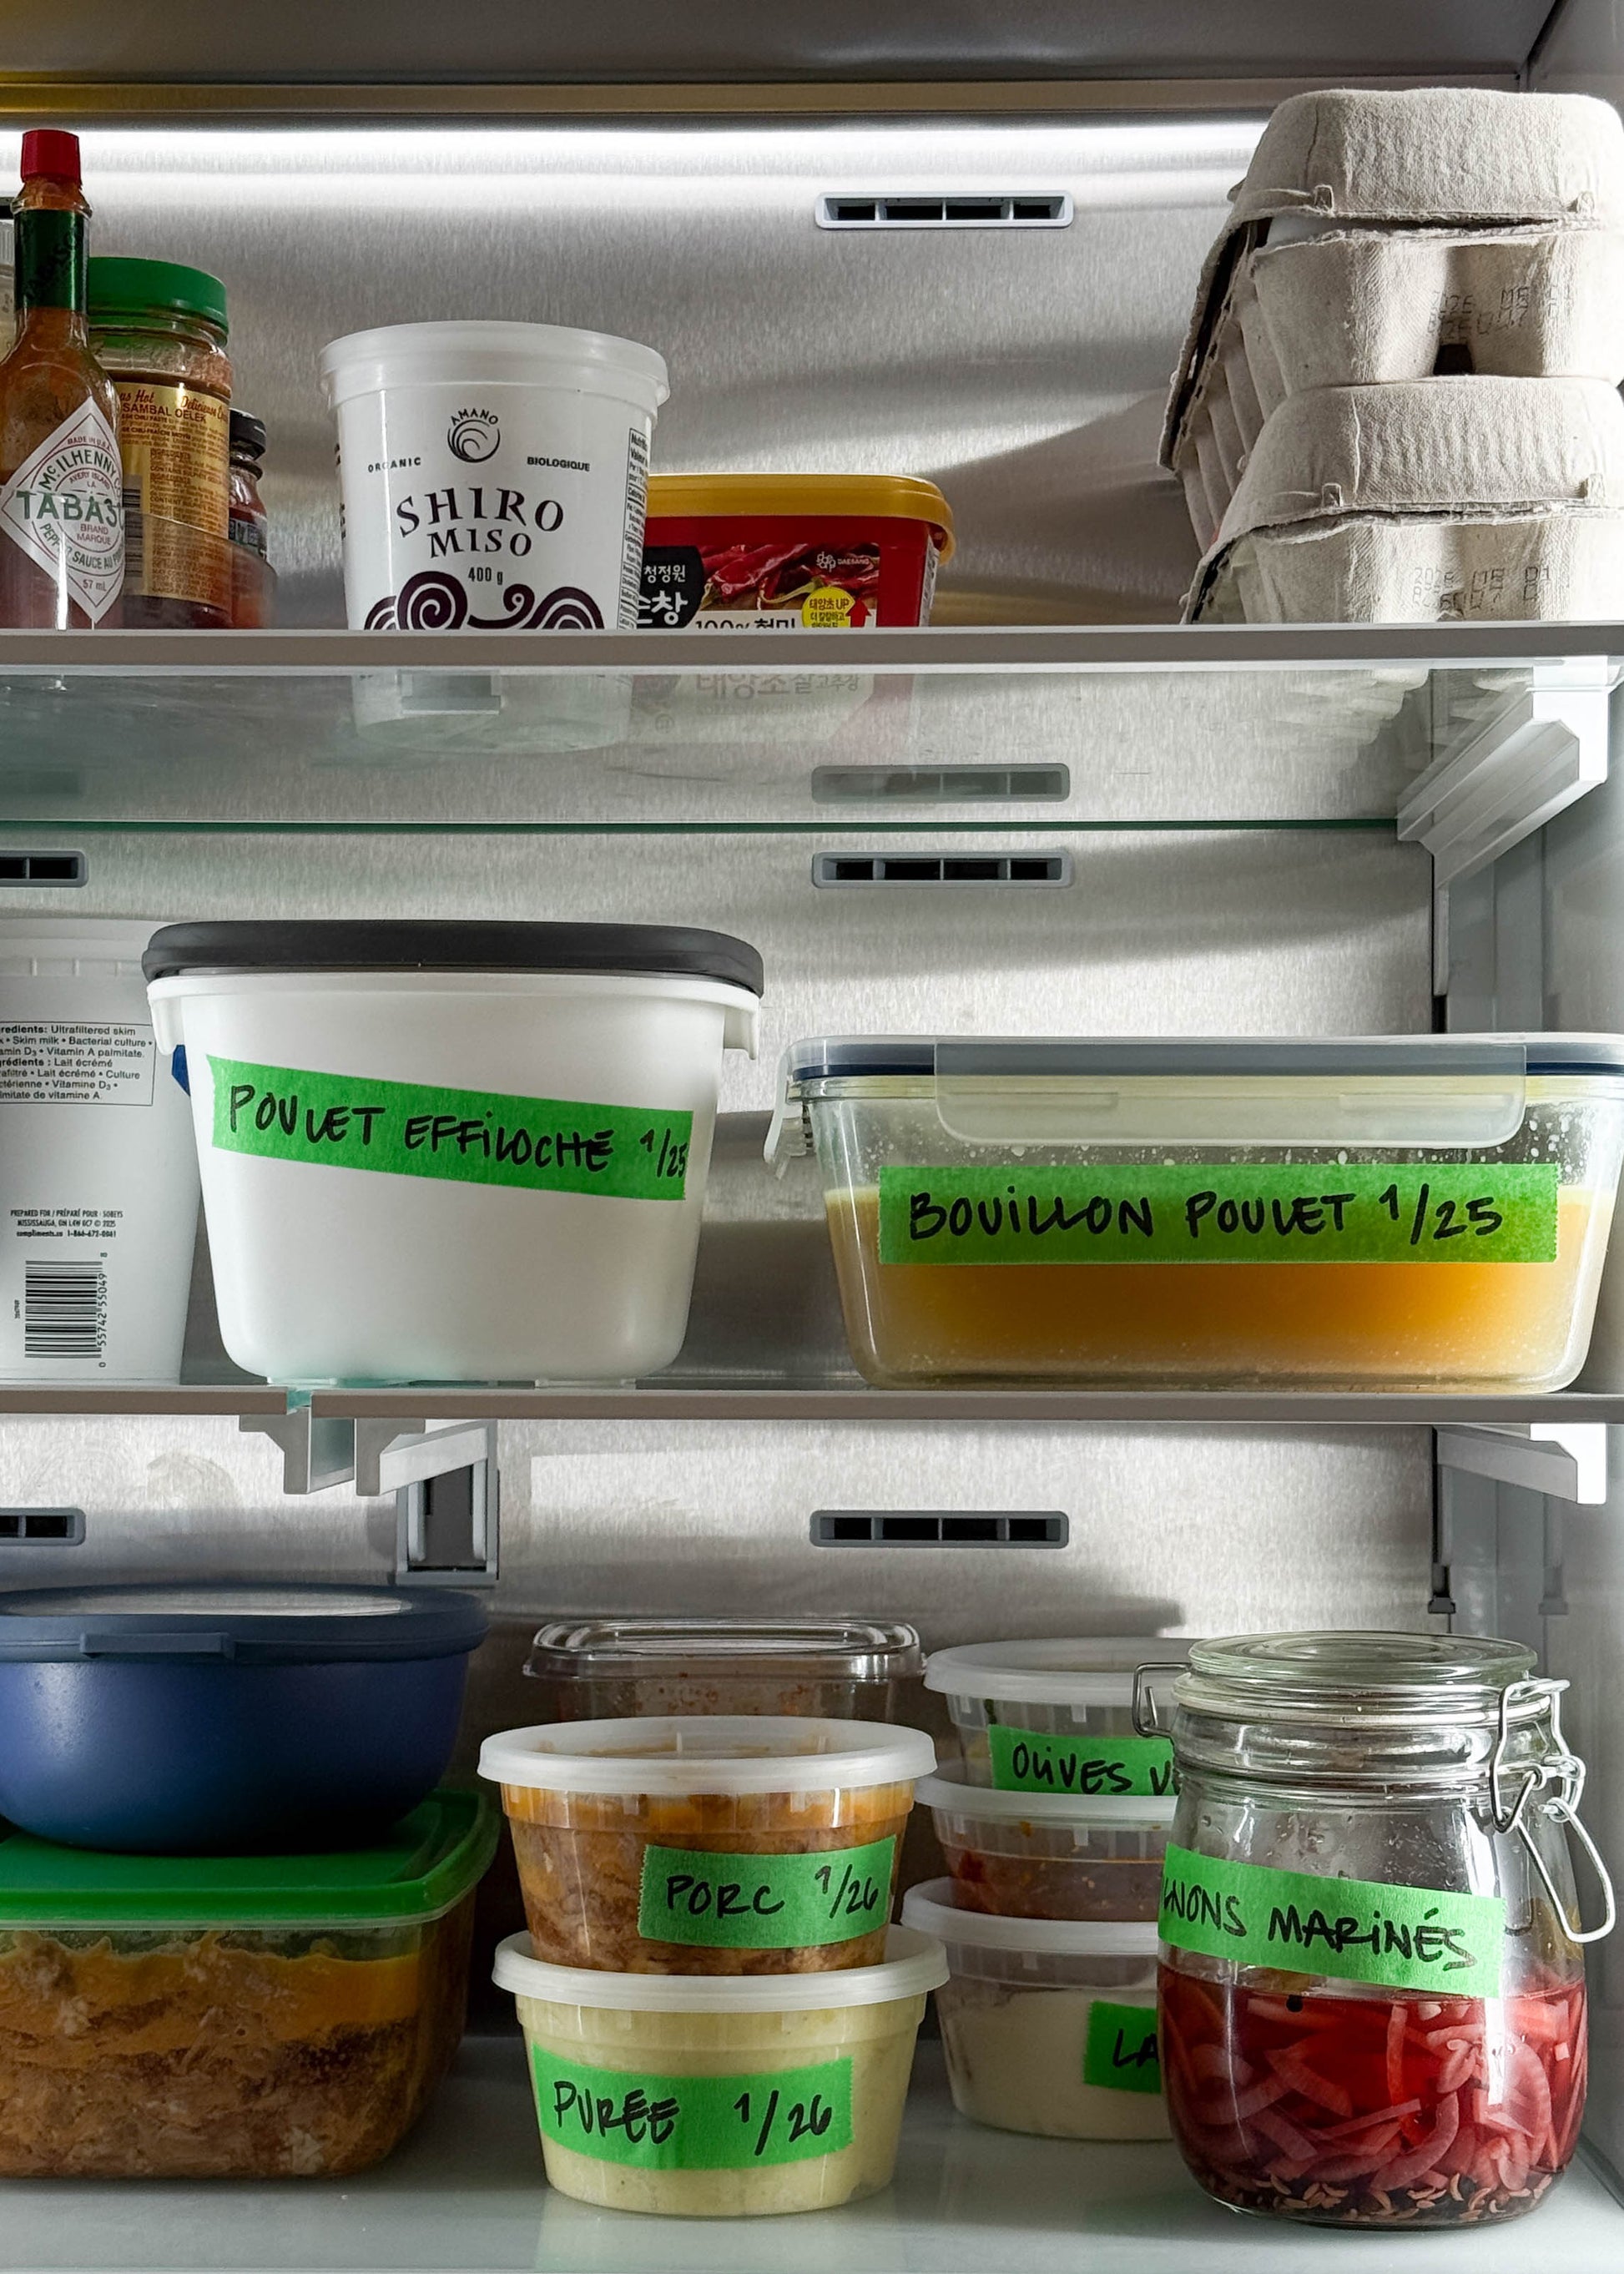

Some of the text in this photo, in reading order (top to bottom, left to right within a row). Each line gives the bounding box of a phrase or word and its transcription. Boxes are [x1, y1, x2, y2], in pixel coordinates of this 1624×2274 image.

[123, 402, 172, 417] SAMBAL
[174, 408, 207, 424] OELEK
[451, 408, 498, 426] AMANO
[368, 456, 590, 472] ORGANIC BIOLOGIQUE
[69, 472, 89, 484] AVERY
[396, 487, 563, 537] SHIRO
[81, 523, 108, 534] BRAND
[77, 533, 112, 546] MARQUE
[427, 528, 532, 558] MISO
[73, 552, 102, 569] SAUCE
[468, 567, 503, 585] 400 g
[644, 565, 686, 583] 청정원
[83, 579, 93, 588] 57
[836, 597, 850, 609] UP
[1, 1026, 135, 1036] redients: Ultrafiltered skim
[13, 1036, 36, 1045] Skim
[39, 1036, 58, 1045] milk
[68, 1036, 112, 1046] Bacterial
[114, 1038, 146, 1047] culture
[47, 1046, 84, 1056] Vitamin
[88, 1047, 95, 1056] A
[54, 1057, 73, 1066] Lait
[76, 1056, 113, 1068] écrémé
[1, 1067, 140, 1080] afiltré Lait écrémé Culture
[52, 1079, 95, 1089] Vitamine
[33, 1091, 45, 1100] de
[48, 1091, 89, 1100] vitamine
[640, 1128, 688, 1179] 1/25
[83, 1209, 98, 1218] POUR
[1186, 1192, 1355, 1238] POULET
[1379, 1183, 1503, 1245] 1/25
[98, 1273, 108, 1307] 55049
[97, 1313, 107, 1347] 55742
[667, 1863, 880, 1920] PORC 1/26
[734, 2088, 833, 2157] 1/26
